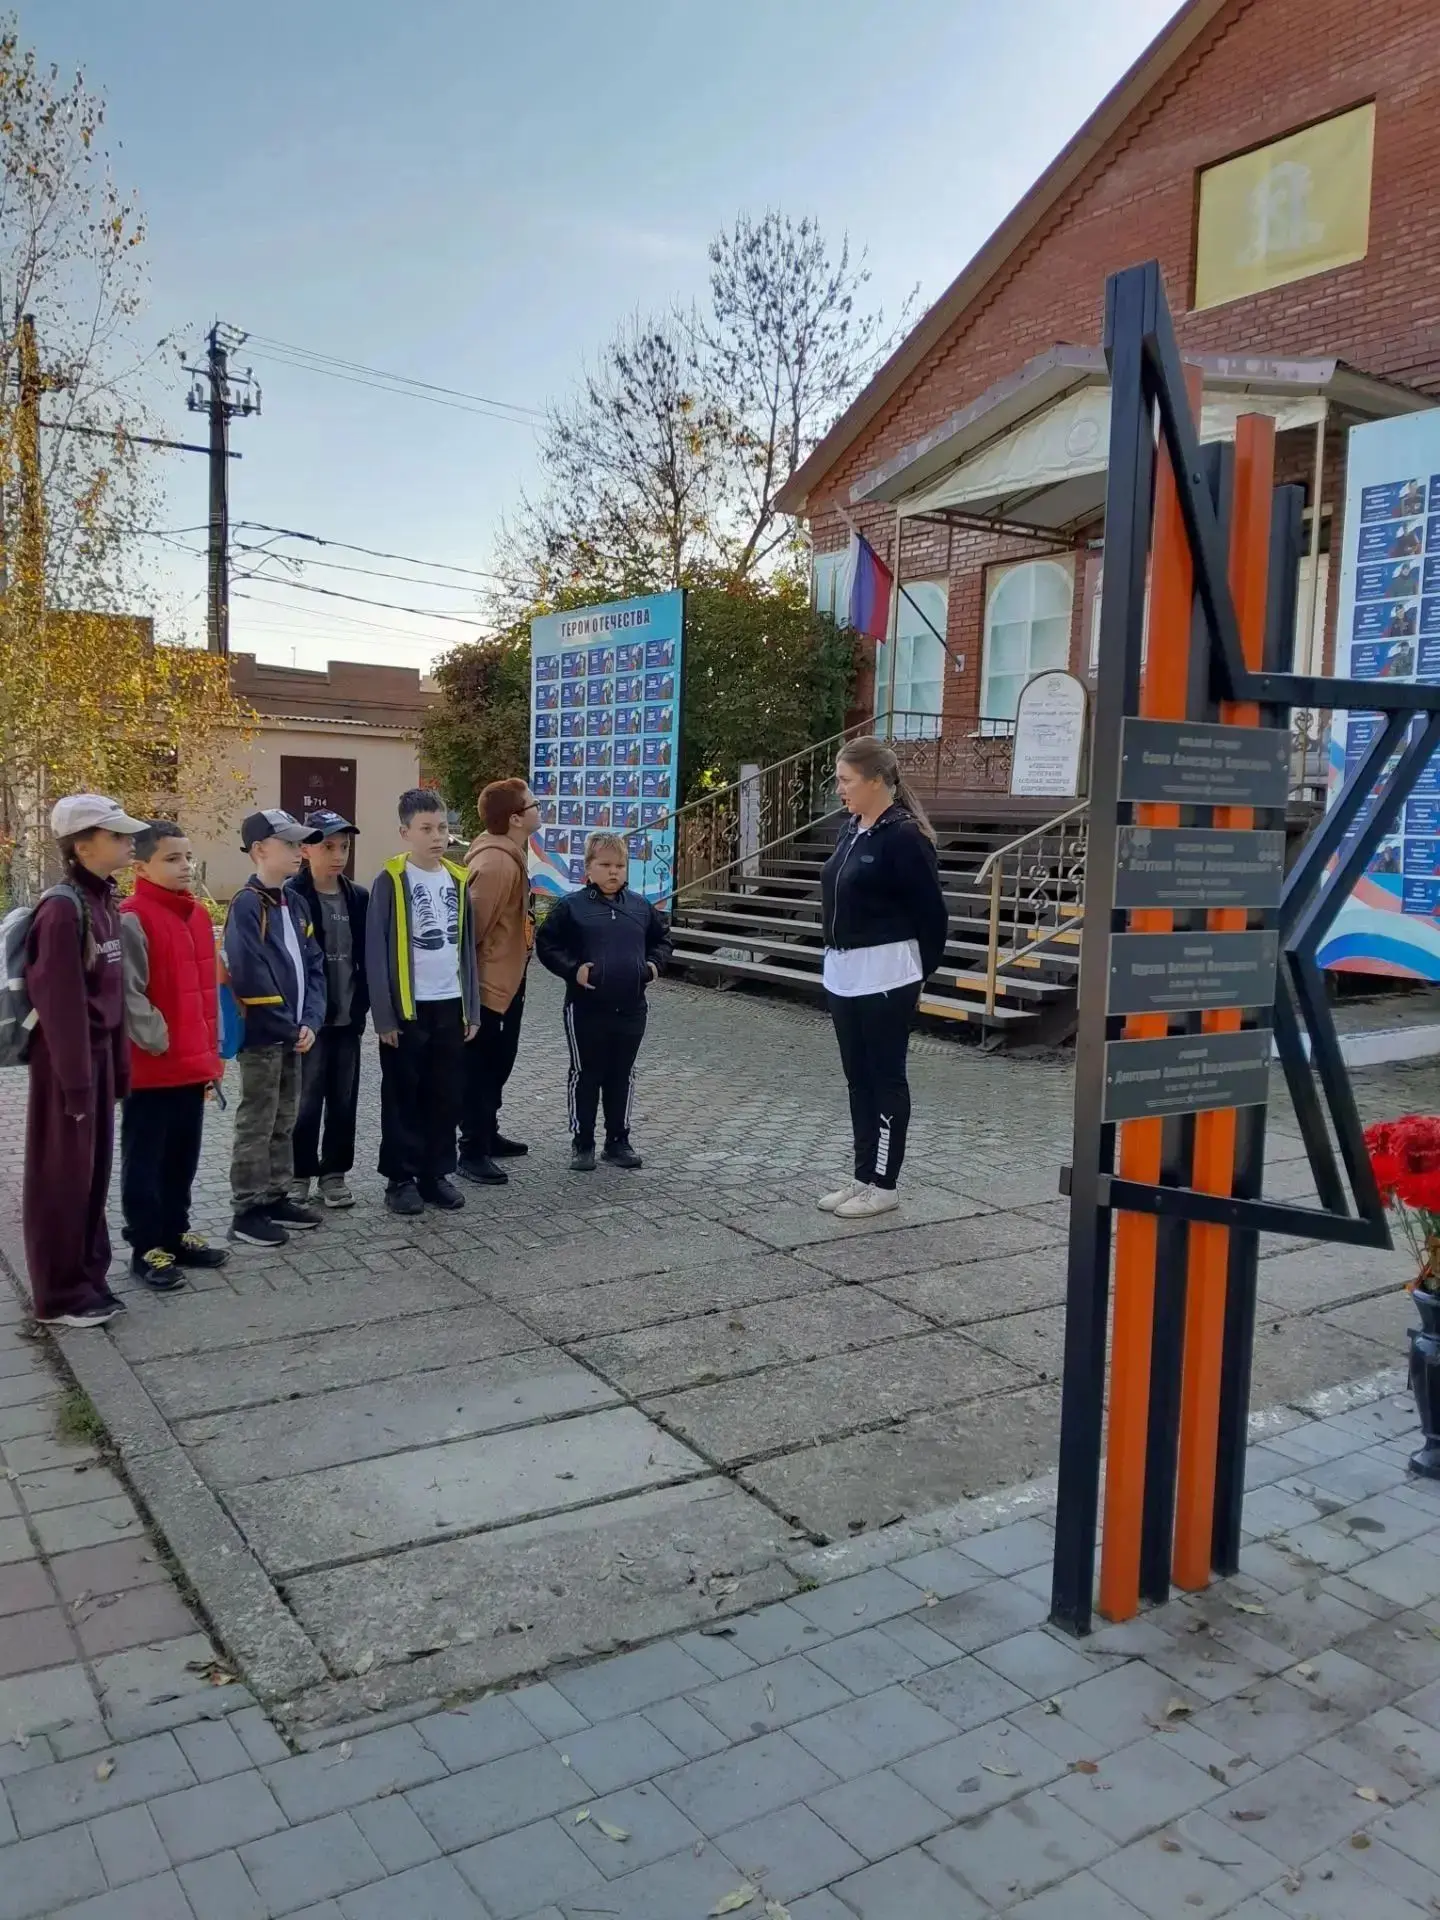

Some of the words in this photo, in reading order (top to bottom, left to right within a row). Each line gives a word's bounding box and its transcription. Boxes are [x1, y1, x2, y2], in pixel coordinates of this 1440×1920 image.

[561, 619, 590, 637] ГЕРОИ
[592, 608, 650, 633] ОТЕЧЕСТВА
[875, 1126, 890, 1176] PUMA
